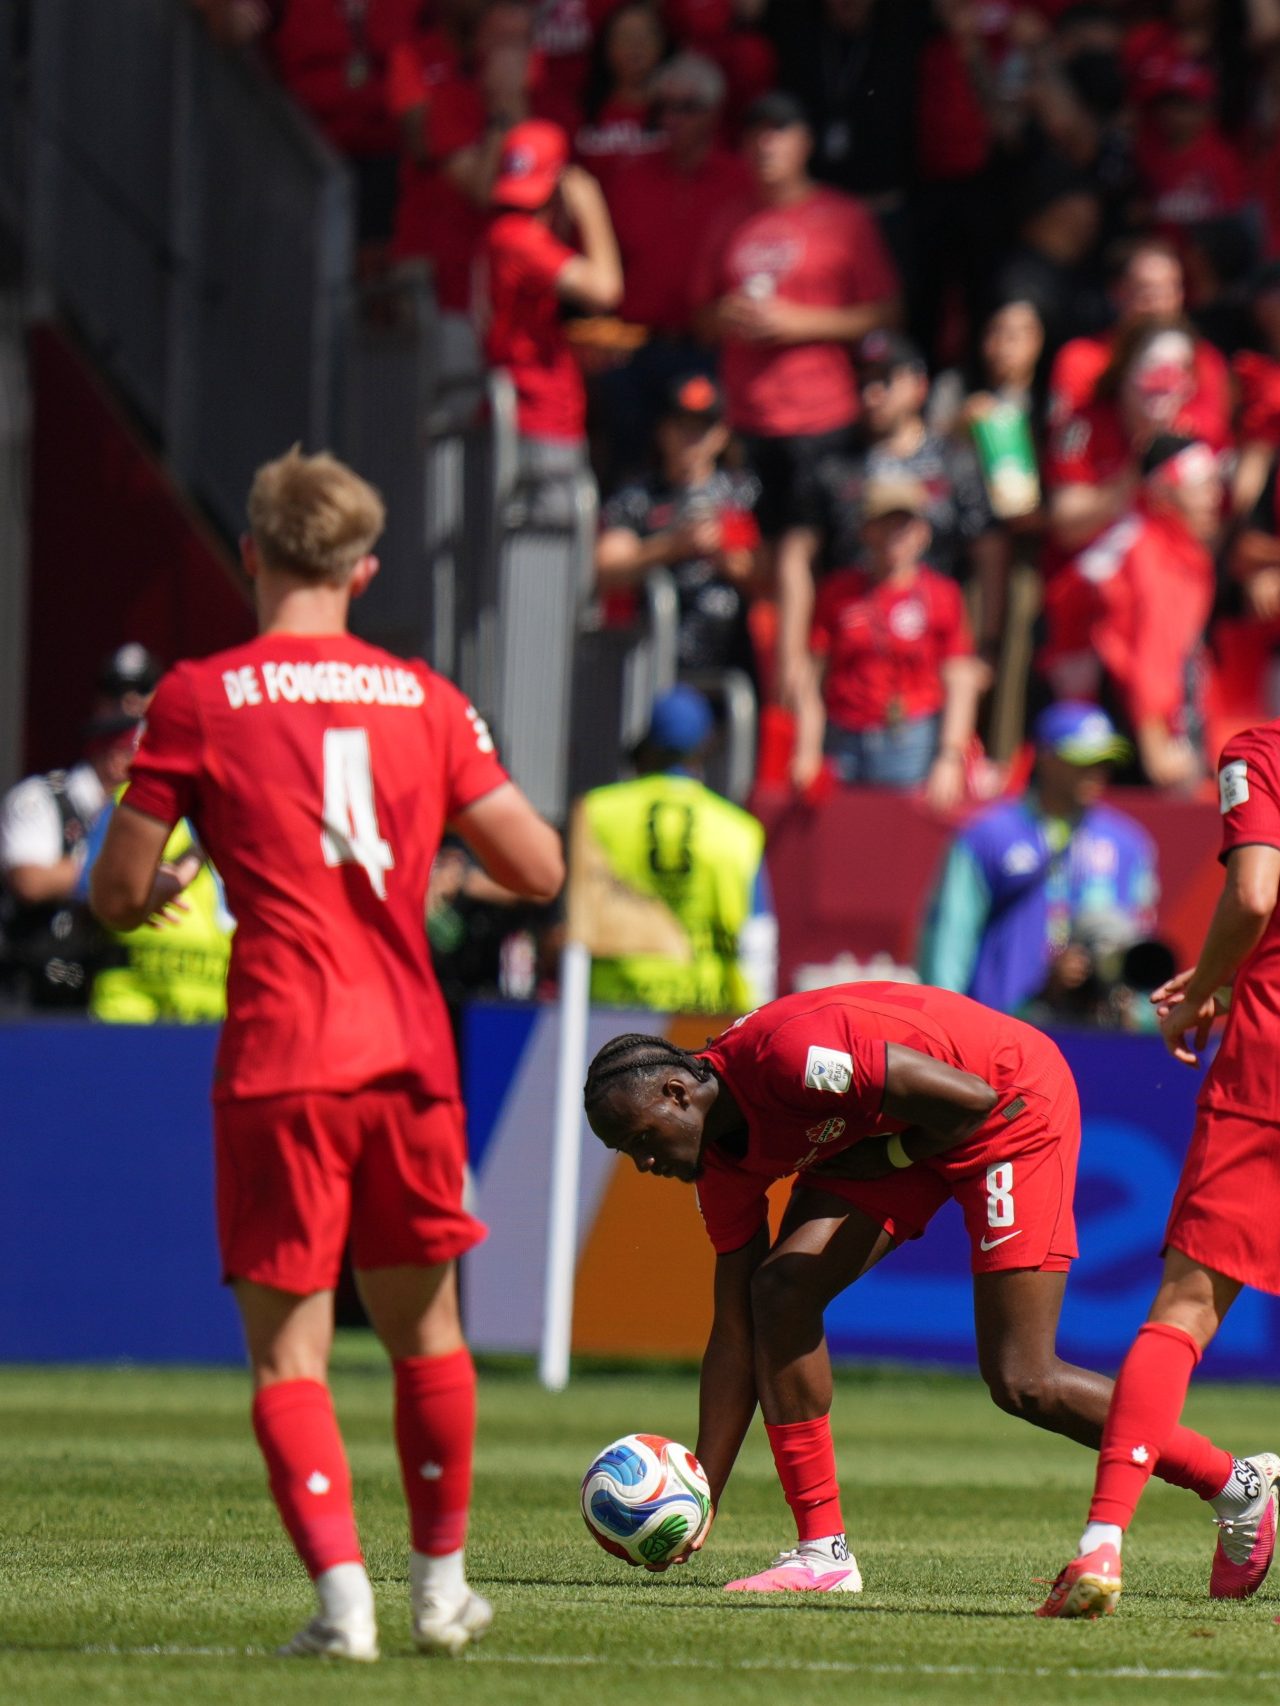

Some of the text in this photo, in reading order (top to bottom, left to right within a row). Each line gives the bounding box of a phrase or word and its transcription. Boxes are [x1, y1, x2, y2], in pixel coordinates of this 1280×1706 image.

[222, 661, 425, 709] DE FOUGEROLLES
[320, 727, 395, 900] 4
[986, 1161, 1015, 1228] 8
